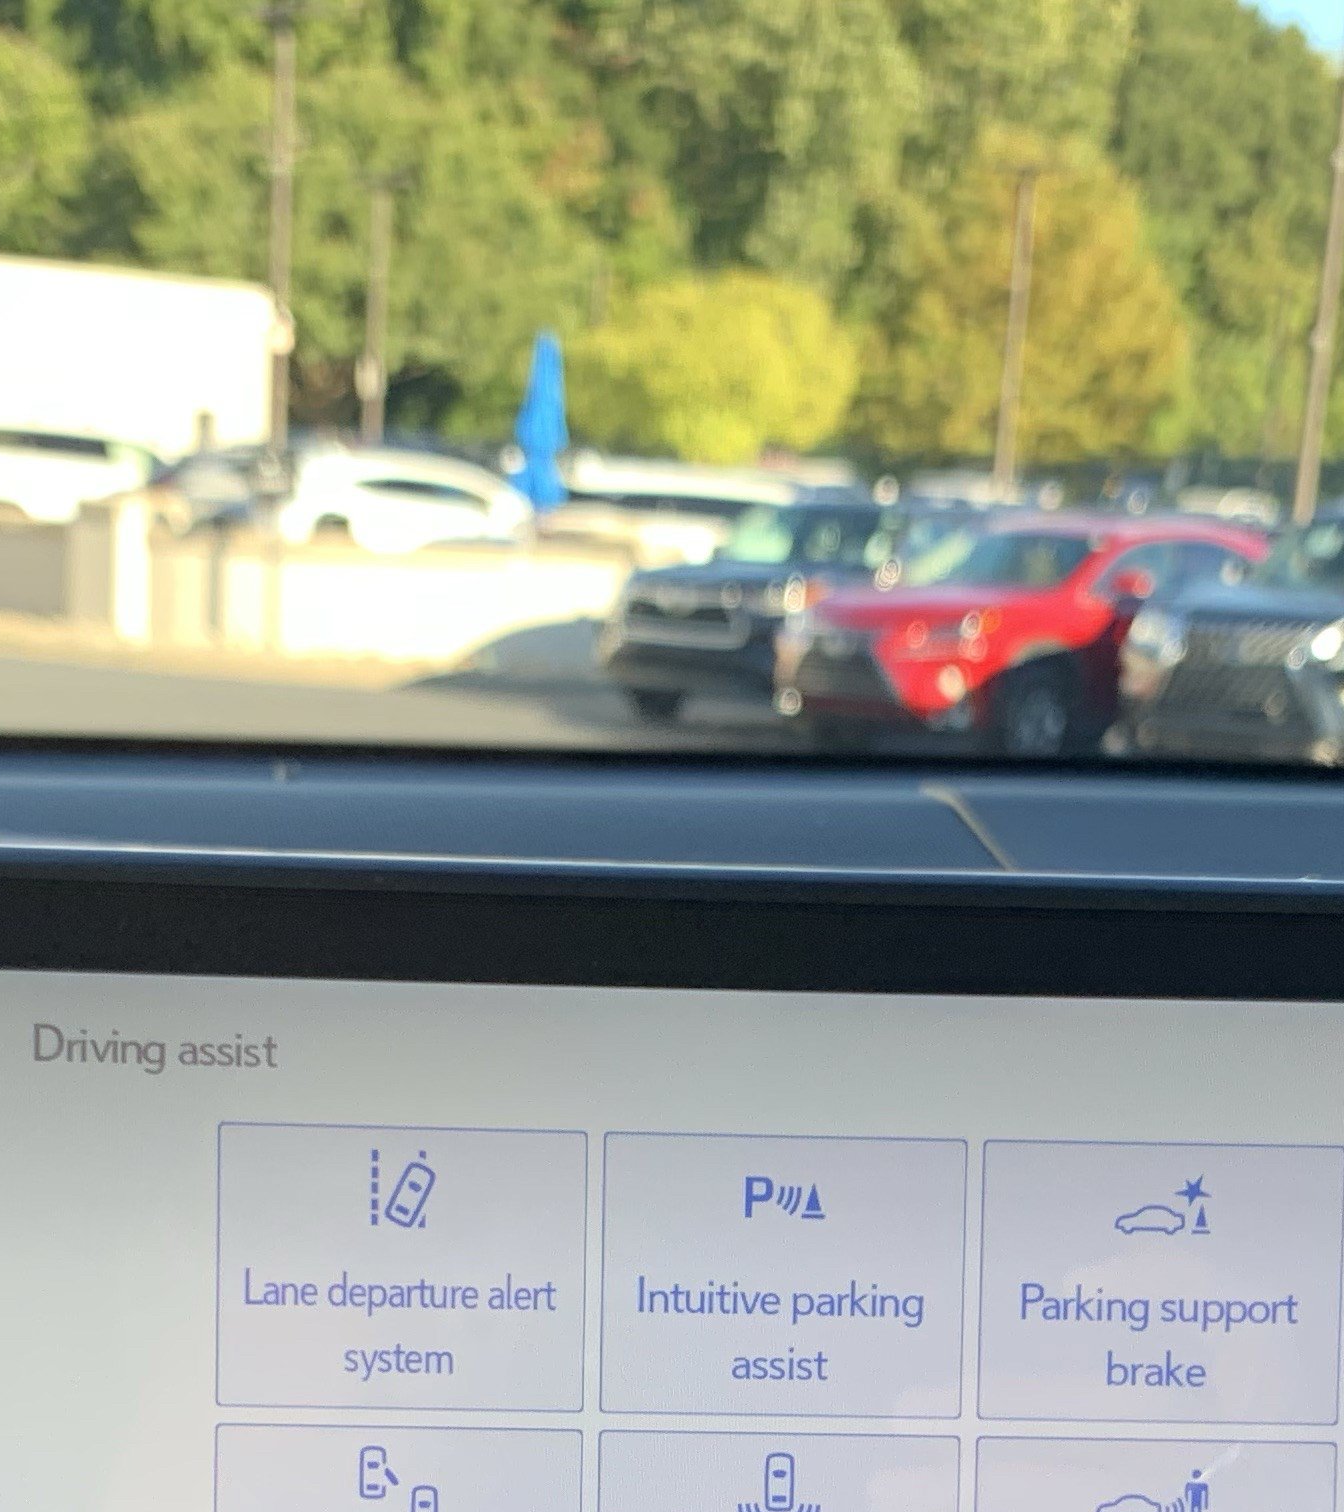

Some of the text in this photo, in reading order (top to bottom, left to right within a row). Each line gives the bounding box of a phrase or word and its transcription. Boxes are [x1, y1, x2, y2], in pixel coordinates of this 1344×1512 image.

[34, 1023, 166, 1075] Driving
[178, 1034, 277, 1067] assist
[245, 1268, 556, 1317] Lane departure alert
[639, 1276, 924, 1327] Intuitive parking
[1022, 1283, 1298, 1332] Parking support
[345, 1344, 453, 1381] system
[732, 1347, 828, 1380] assist
[1107, 1350, 1206, 1387] brake
